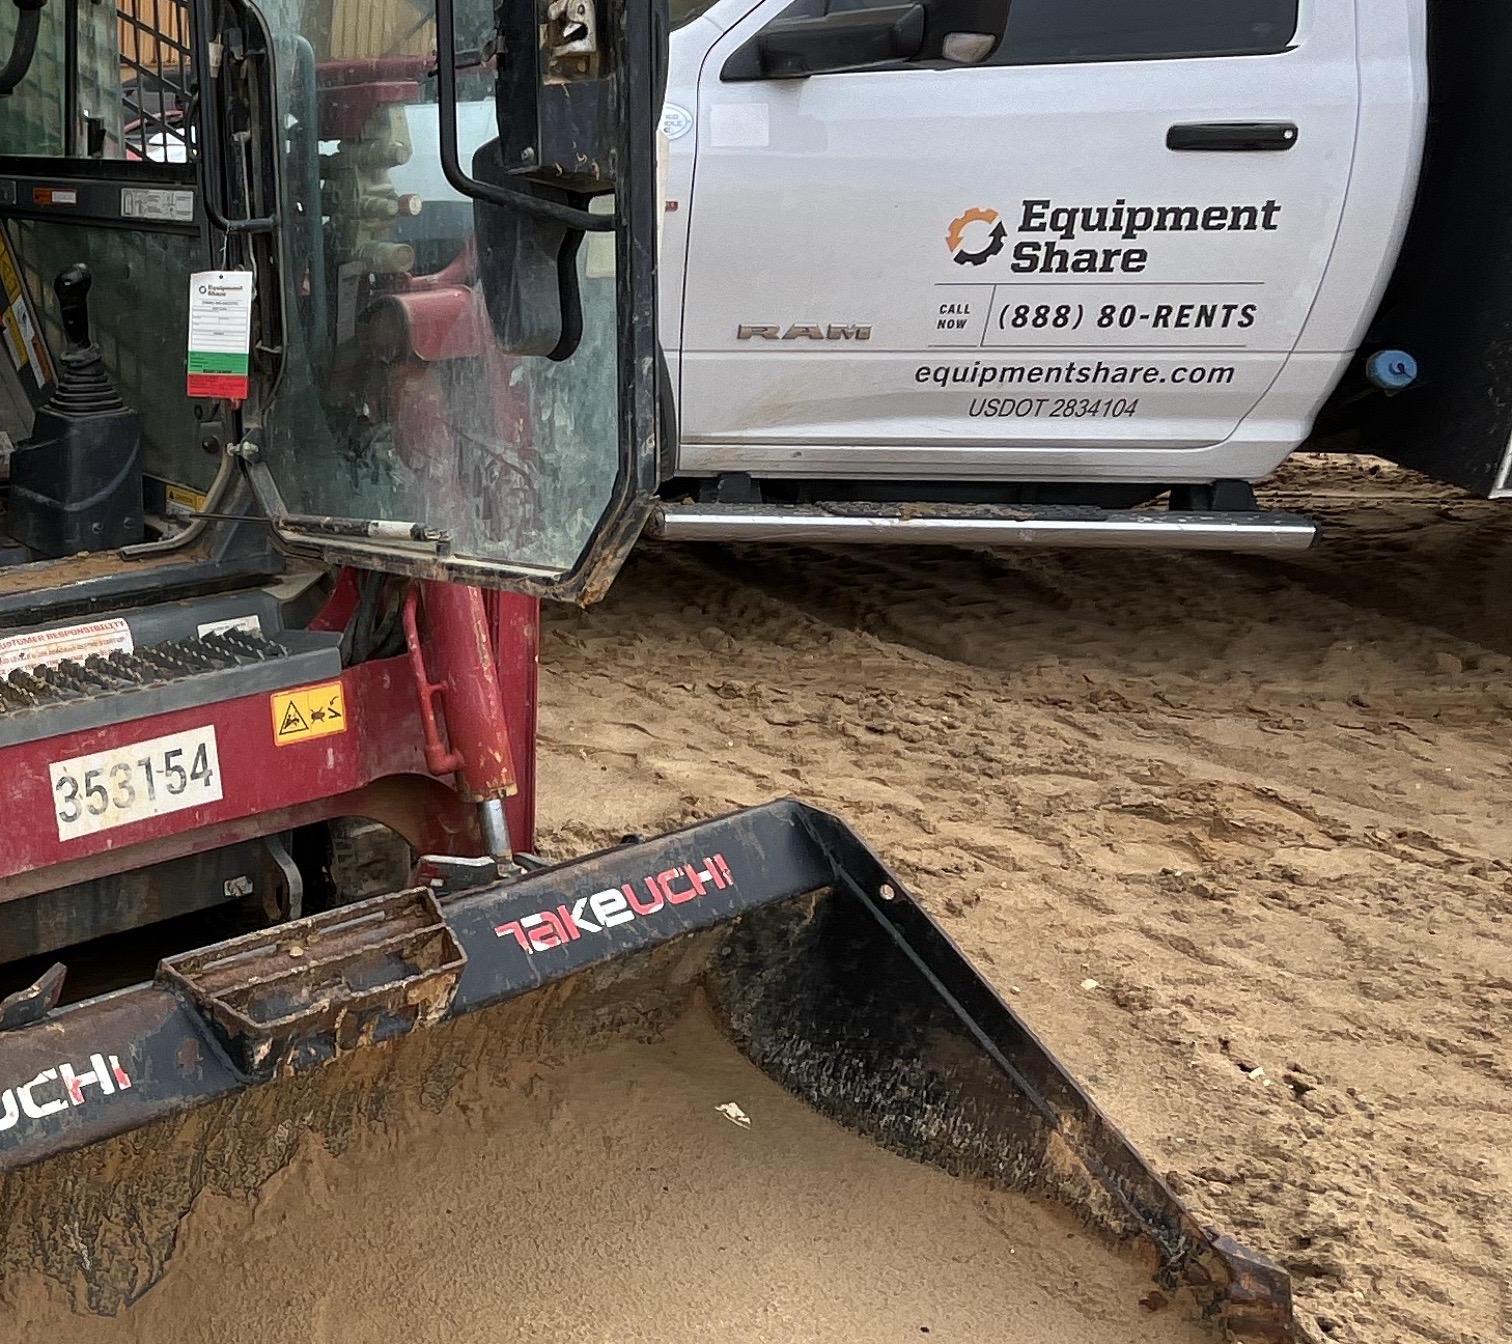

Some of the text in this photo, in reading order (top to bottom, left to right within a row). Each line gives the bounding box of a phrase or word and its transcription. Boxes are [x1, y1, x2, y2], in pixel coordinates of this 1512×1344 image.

[1018, 199, 1281, 239] Equipment
[1010, 241, 1149, 274] Share
[938, 304, 971, 315] CALL
[997, 304, 1258, 330] (888) 80-RENTS
[736, 323, 872, 341] RAM
[936, 319, 968, 330] NOW
[914, 359, 1236, 387] equipmentshare.com
[968, 398, 1139, 418] USDOT 2834104
[55, 742, 213, 823] 353154
